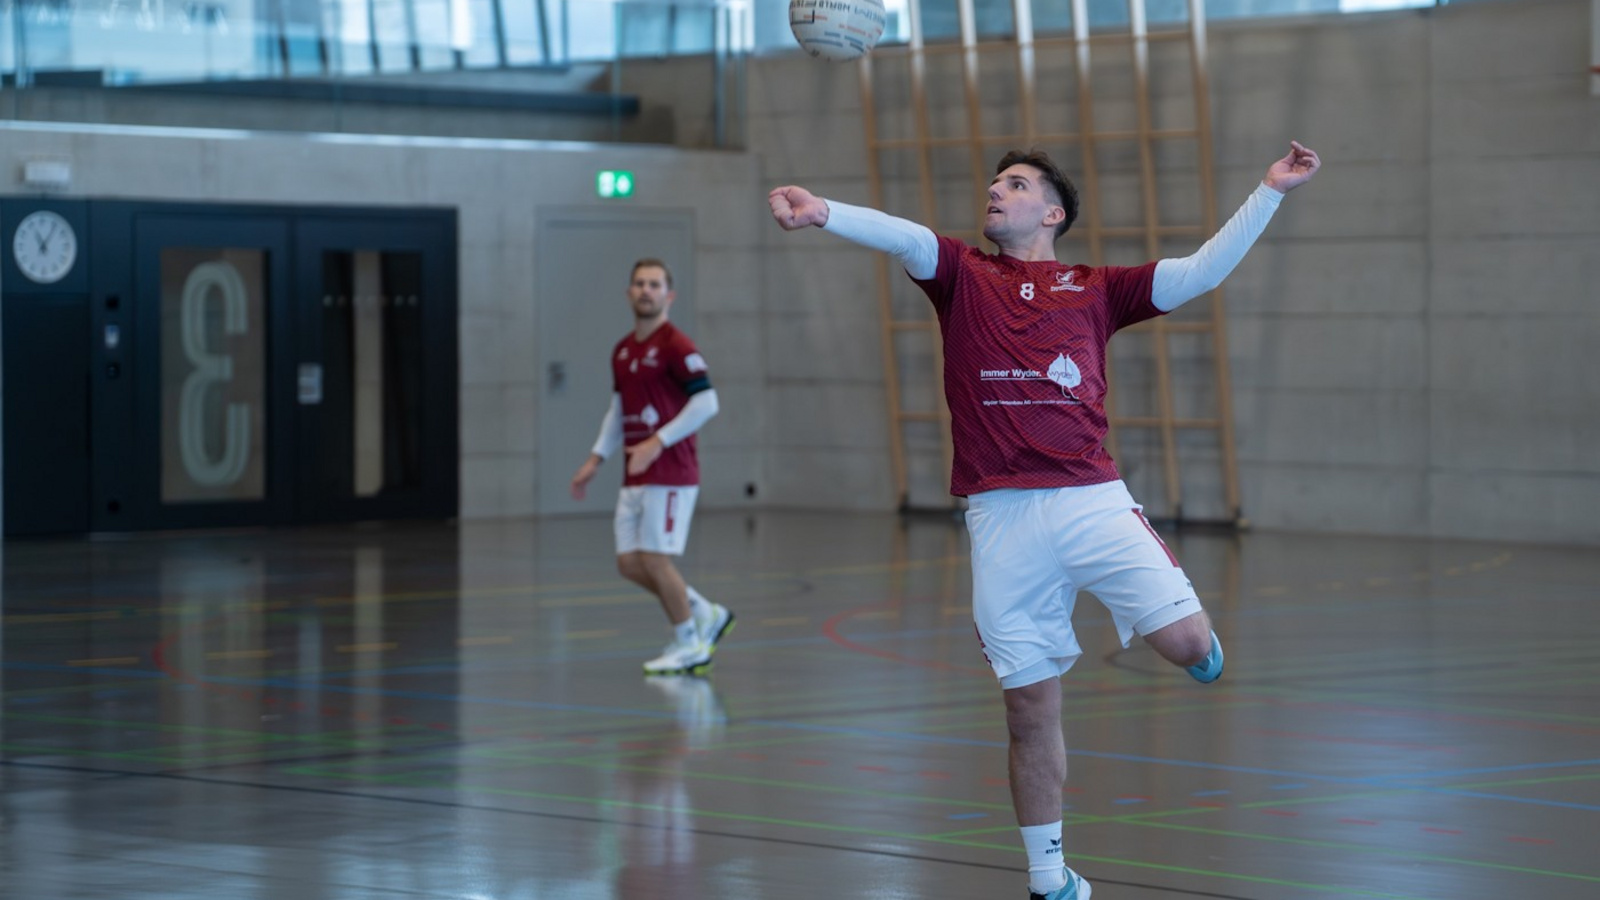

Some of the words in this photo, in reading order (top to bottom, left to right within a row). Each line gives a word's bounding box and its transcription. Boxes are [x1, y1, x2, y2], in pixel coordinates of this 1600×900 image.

[1020, 282, 1034, 300] 8
[981, 369, 1009, 377] Immer
[1011, 368, 1042, 379] Wyder.
